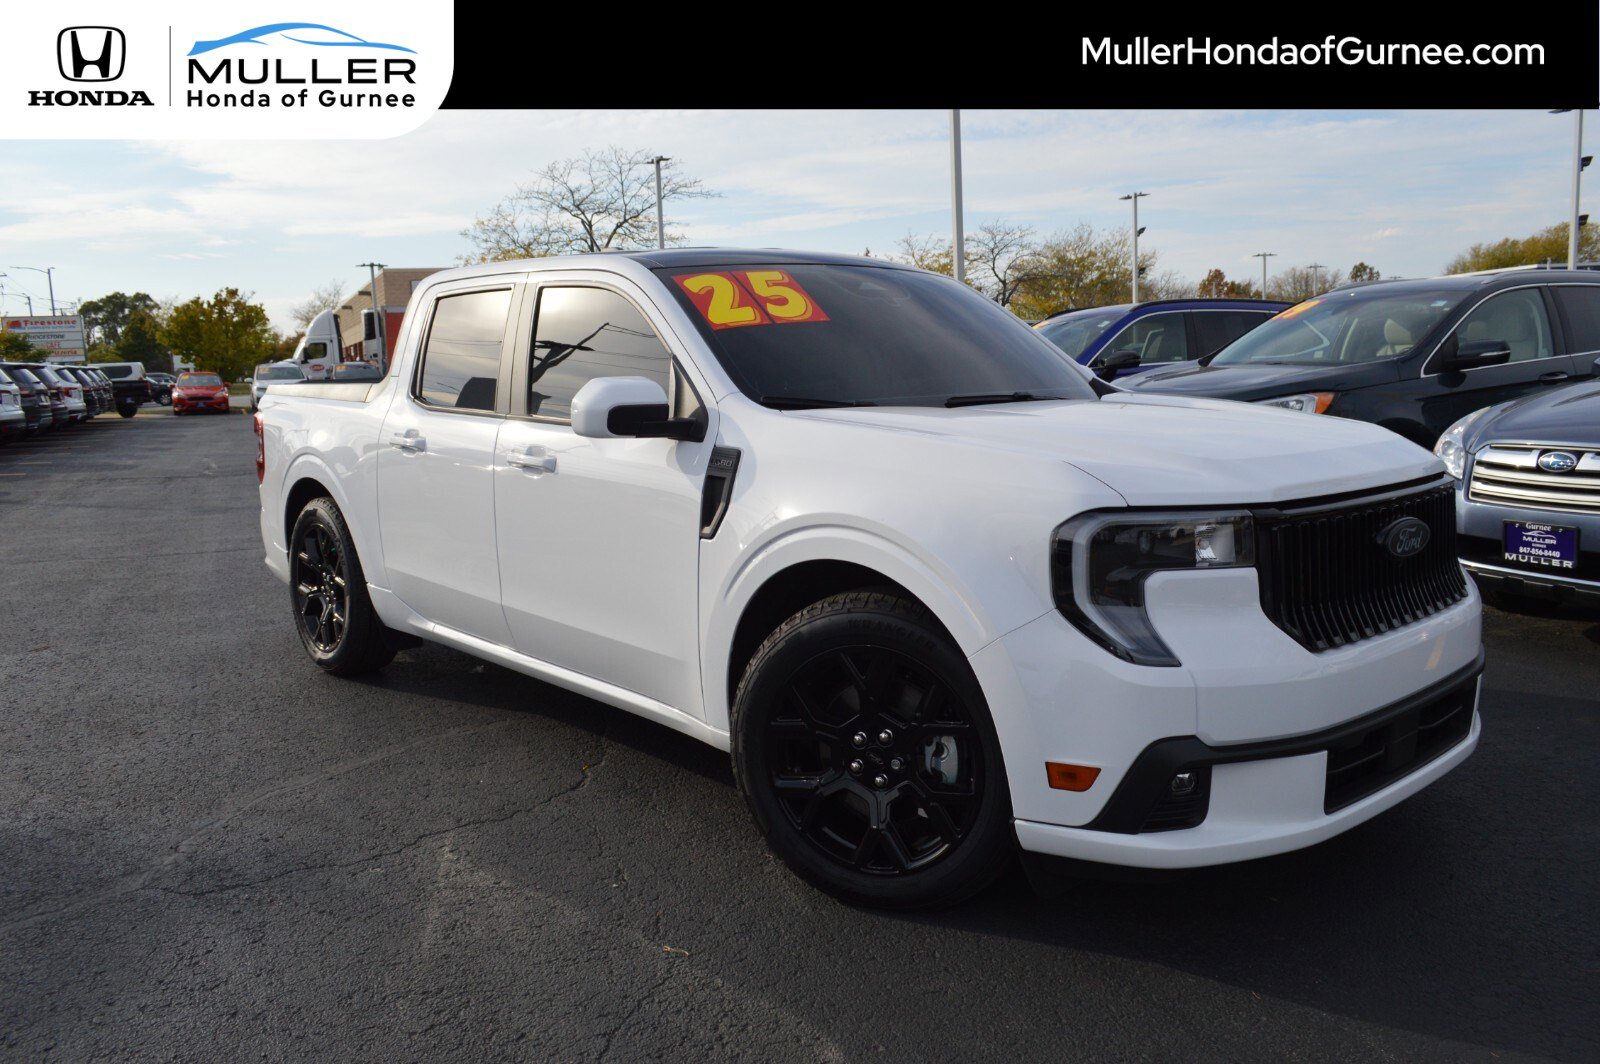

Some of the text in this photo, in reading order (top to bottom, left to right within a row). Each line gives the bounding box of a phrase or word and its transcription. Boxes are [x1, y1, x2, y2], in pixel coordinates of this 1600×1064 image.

[683, 271, 812, 325] 25
[1525, 522, 1552, 531] Gurnee
[1396, 526, 1423, 554] Ford
[1522, 536, 1557, 545] MULLER
[1519, 546, 1561, 558] 847-856-8440
[1504, 553, 1573, 568] MULLER
